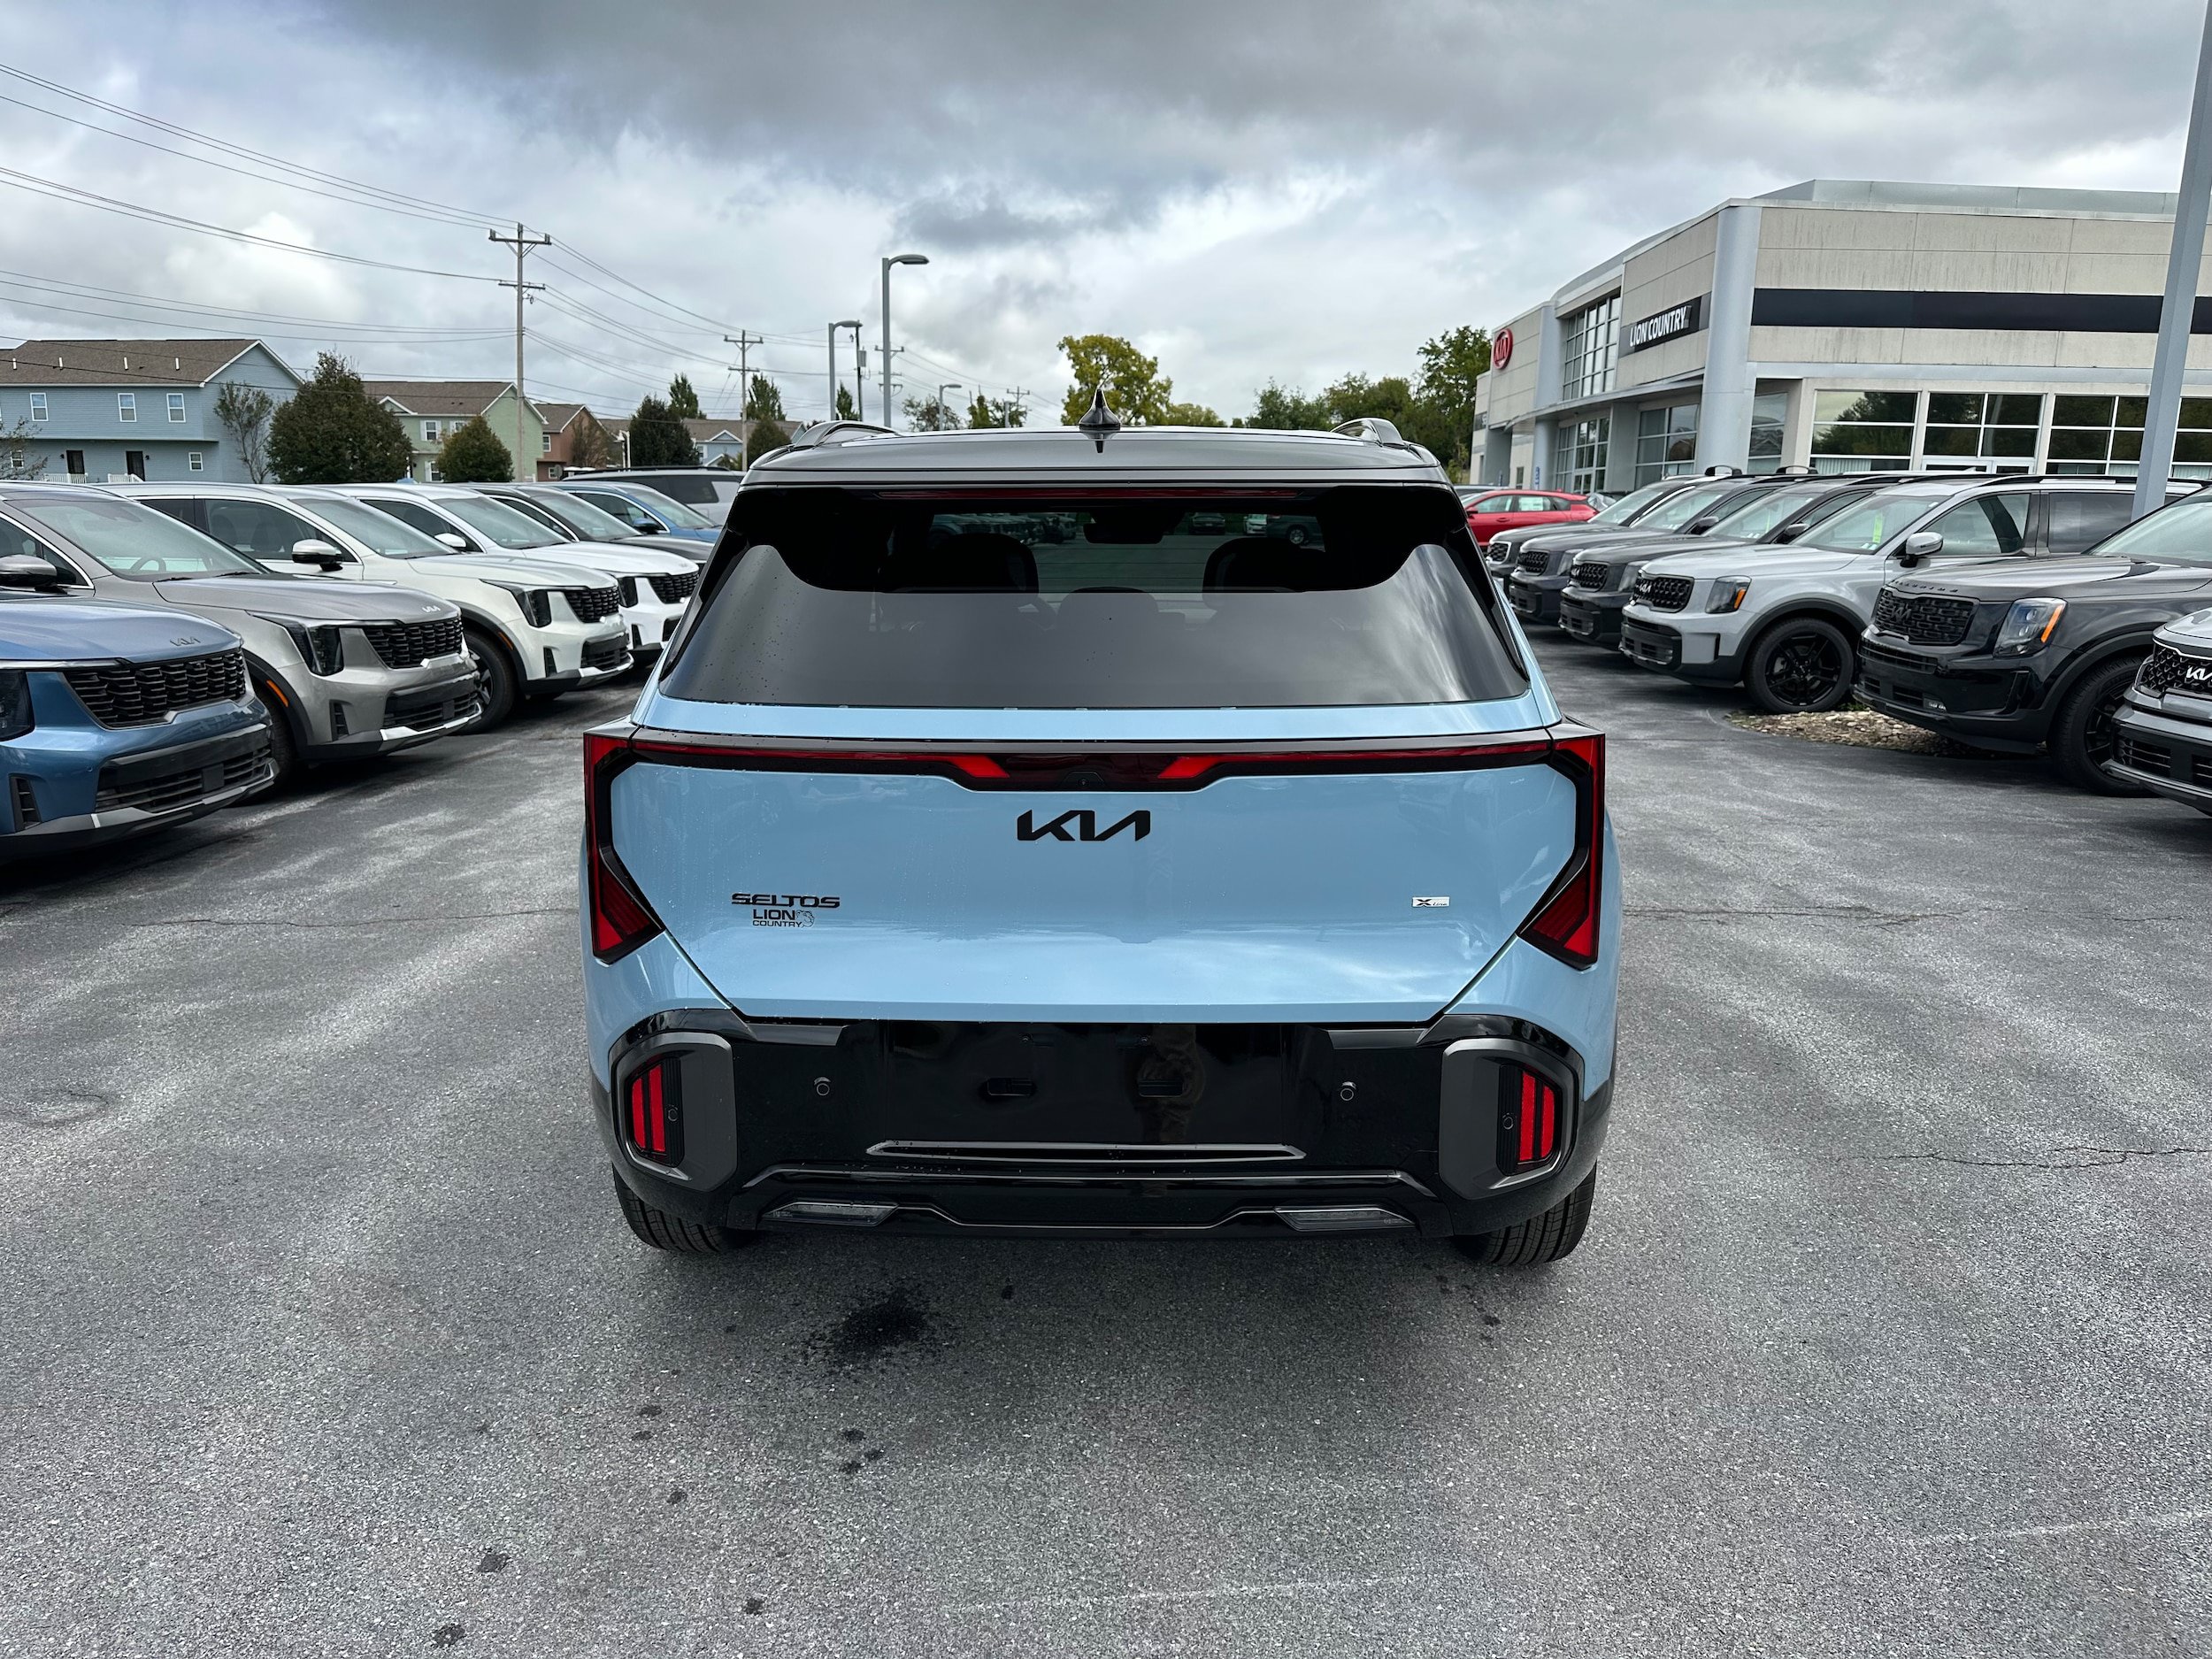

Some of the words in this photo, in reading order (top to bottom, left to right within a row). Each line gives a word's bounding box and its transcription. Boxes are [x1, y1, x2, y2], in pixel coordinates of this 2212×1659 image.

[1630, 321, 1647, 347] LION
[1648, 305, 1687, 341] COUNTRY
[1017, 810, 1151, 841] KIA
[731, 893, 841, 909] SELTOS
[752, 909, 795, 920] LION
